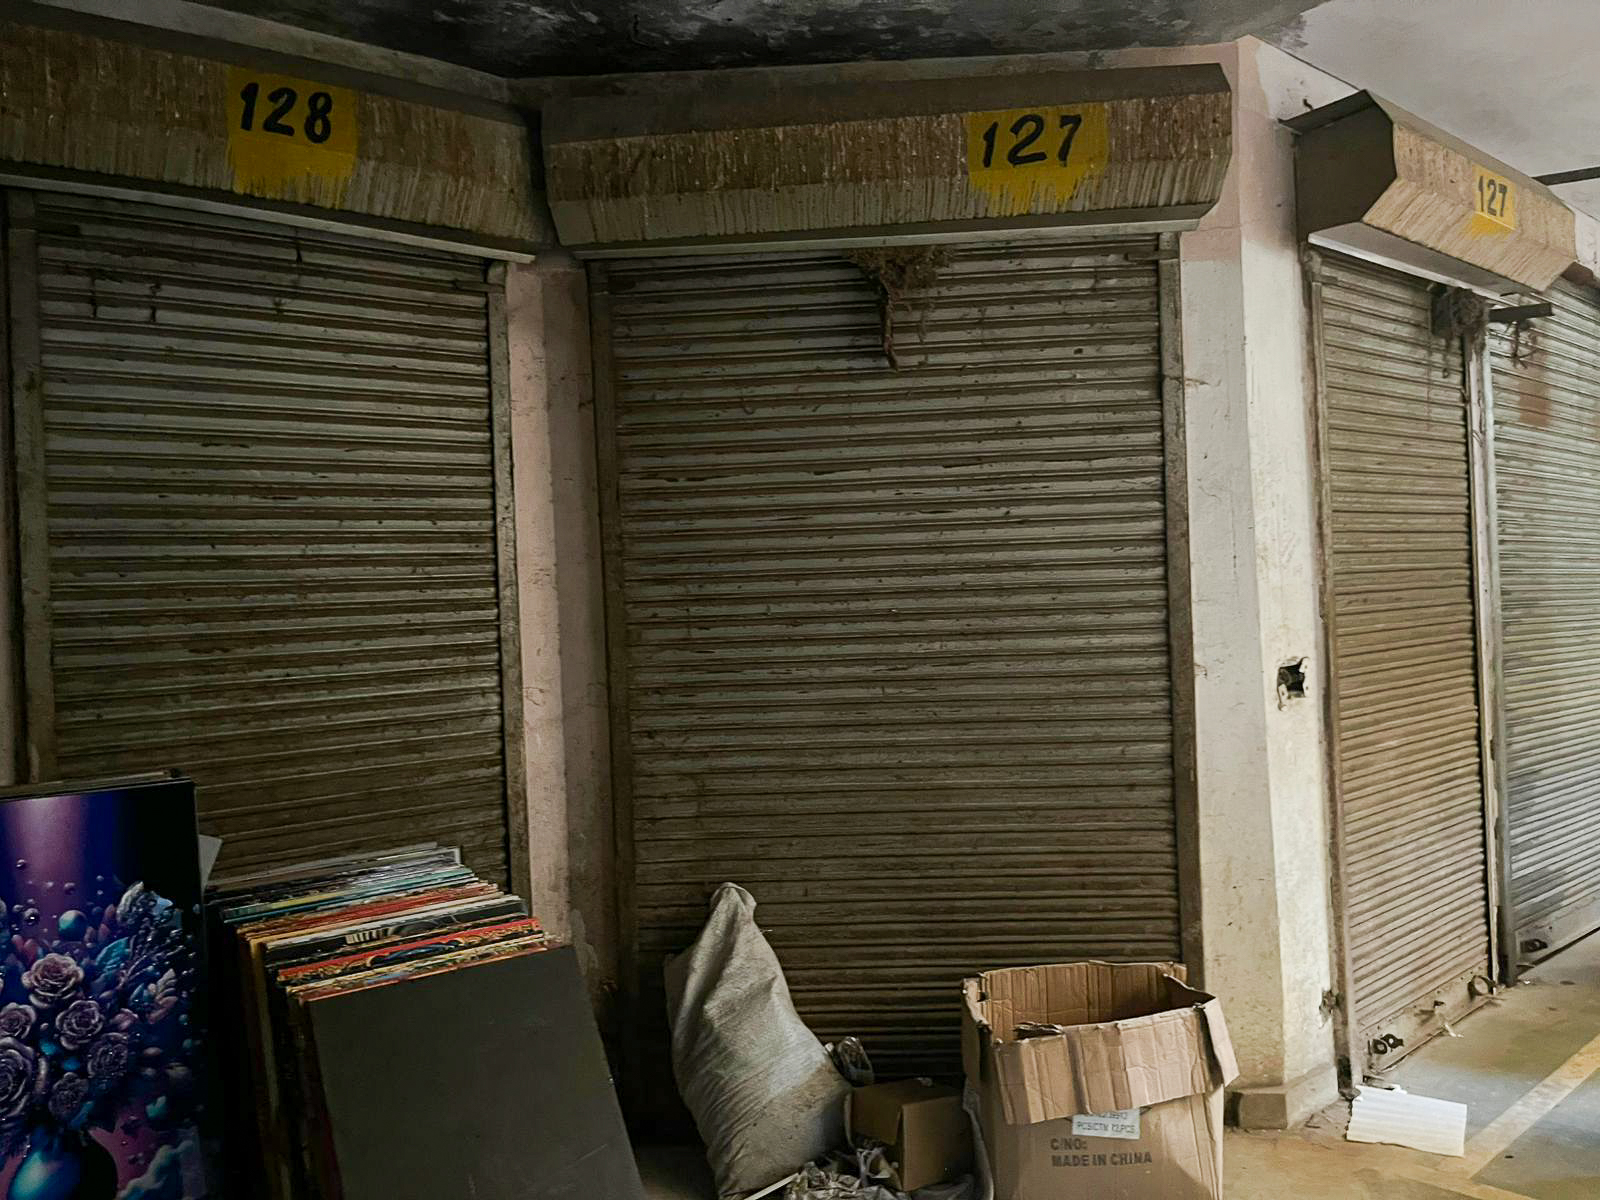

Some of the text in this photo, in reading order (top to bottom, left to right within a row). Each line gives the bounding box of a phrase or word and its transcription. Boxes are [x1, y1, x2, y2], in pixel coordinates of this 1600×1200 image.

[240, 82, 333, 144] 128
[982, 114, 1082, 168] 127
[1478, 175, 1508, 218] 127
[1051, 1151, 1153, 1167] MADE IN CHINA
